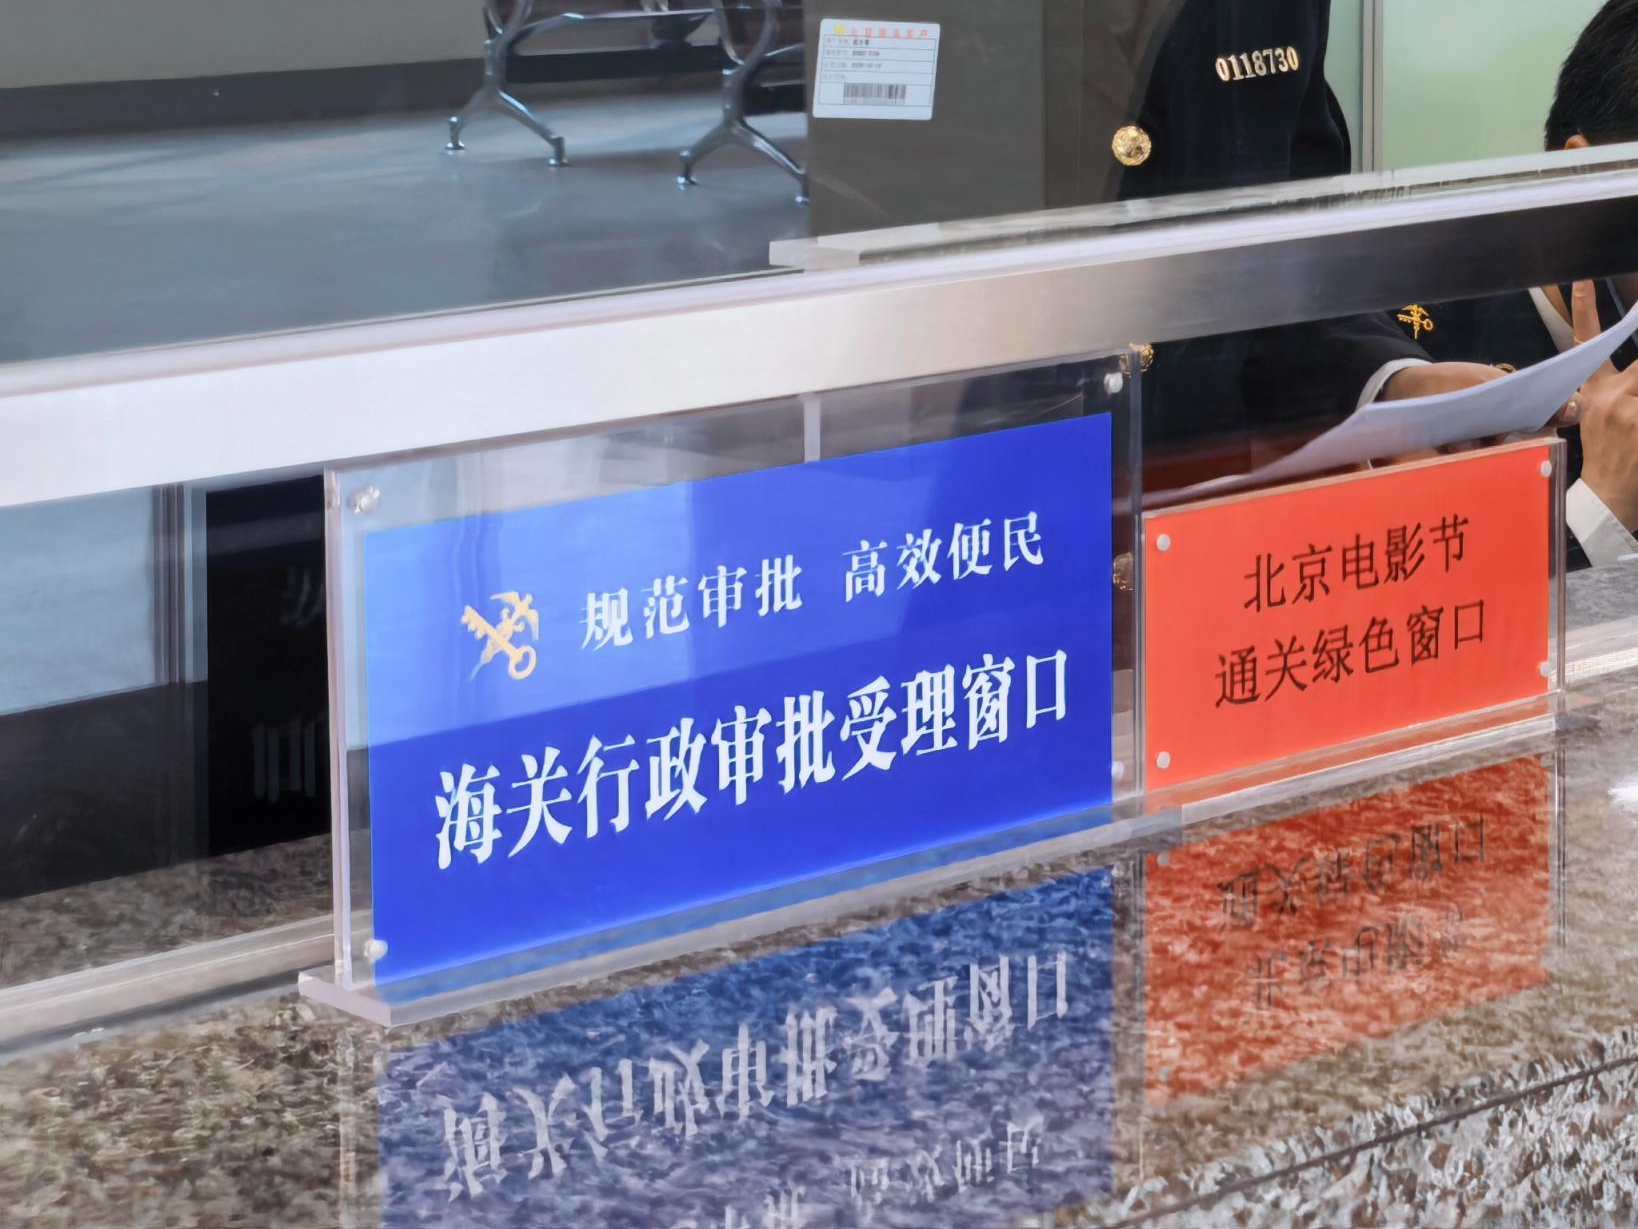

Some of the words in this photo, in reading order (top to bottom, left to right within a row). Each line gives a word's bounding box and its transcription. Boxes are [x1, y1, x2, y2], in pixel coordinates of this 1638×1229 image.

[1215, 45, 1300, 81] 0118730
[580, 553, 804, 652] 规范审批
[843, 510, 1045, 605] 高效便民
[1242, 513, 1471, 613] 北京电影节
[1214, 599, 1486, 708] 通关绿色窗口
[434, 648, 1070, 870] 海关行政审批受理窗口
